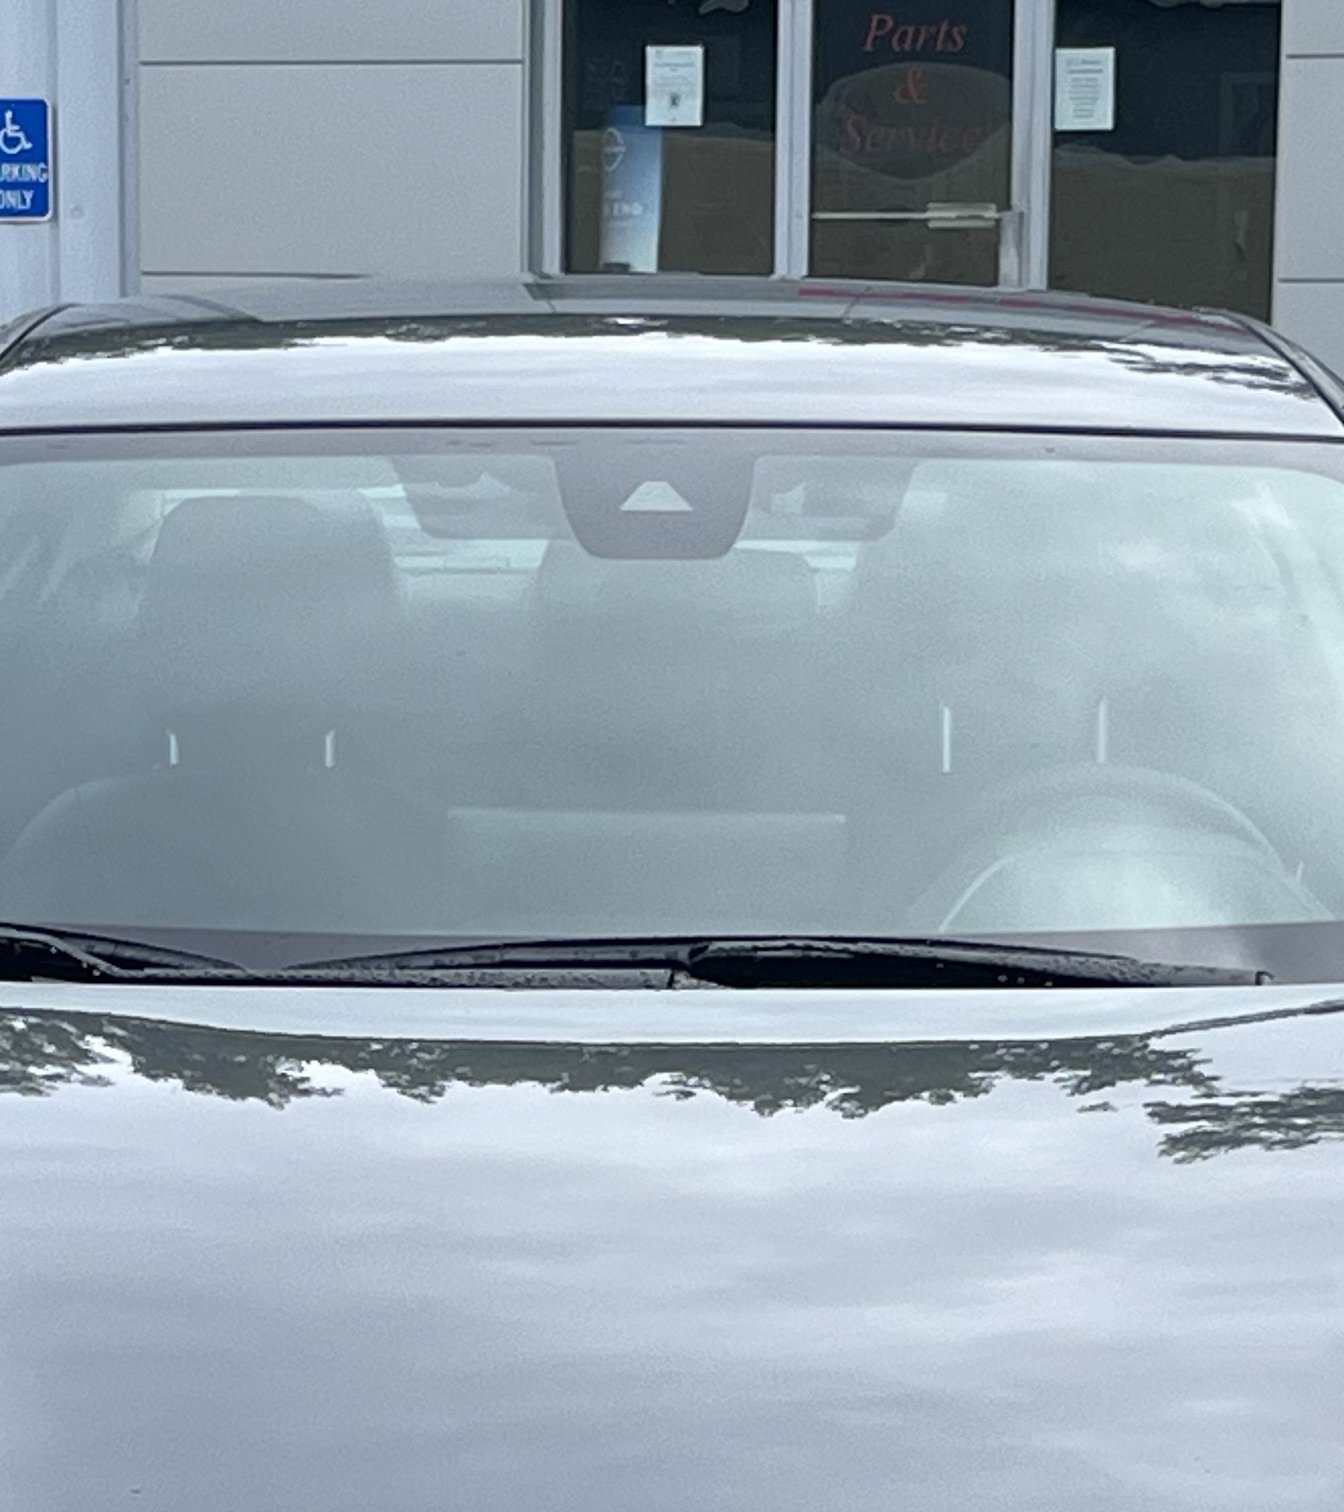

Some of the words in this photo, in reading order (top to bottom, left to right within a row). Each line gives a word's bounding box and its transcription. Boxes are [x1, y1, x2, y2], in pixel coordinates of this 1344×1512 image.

[862, 13, 968, 51] Parts
[894, 65, 927, 104] &
[840, 113, 984, 153] Service
